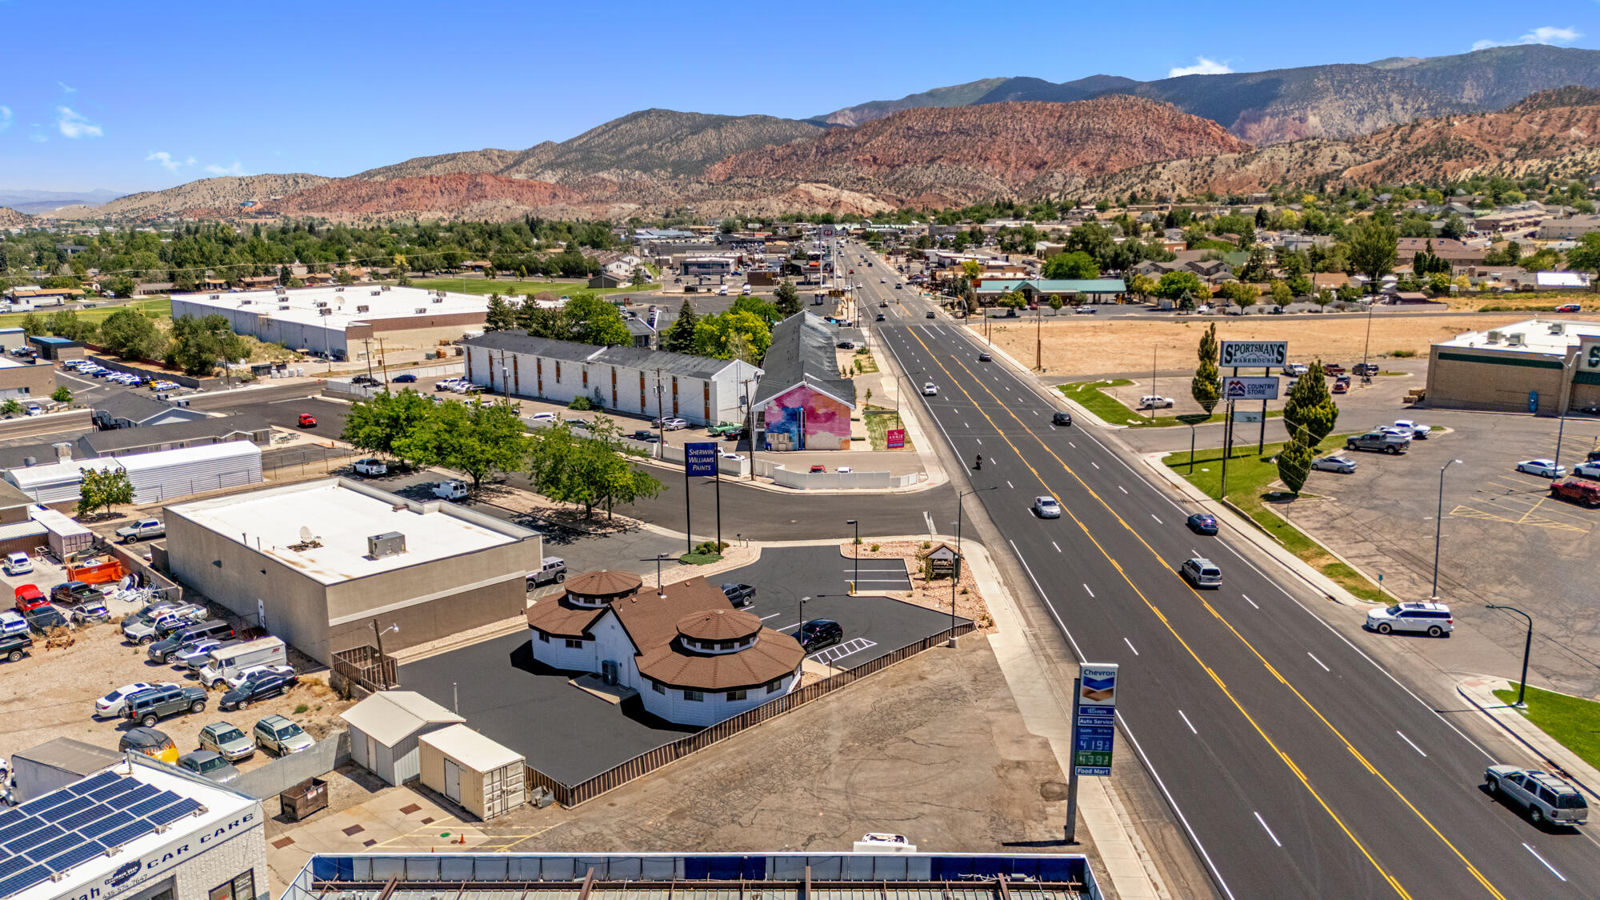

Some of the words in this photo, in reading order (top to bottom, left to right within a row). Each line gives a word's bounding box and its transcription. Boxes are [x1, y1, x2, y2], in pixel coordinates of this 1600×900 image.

[1224, 343, 1286, 365] SPORTSMAN'S
[689, 448, 714, 456] SHERWIN
[688, 456, 715, 464] WILLIAMS
[1083, 668, 1116, 677] Chevron
[147, 844, 189, 869] CAR
[200, 813, 254, 843] CARE
